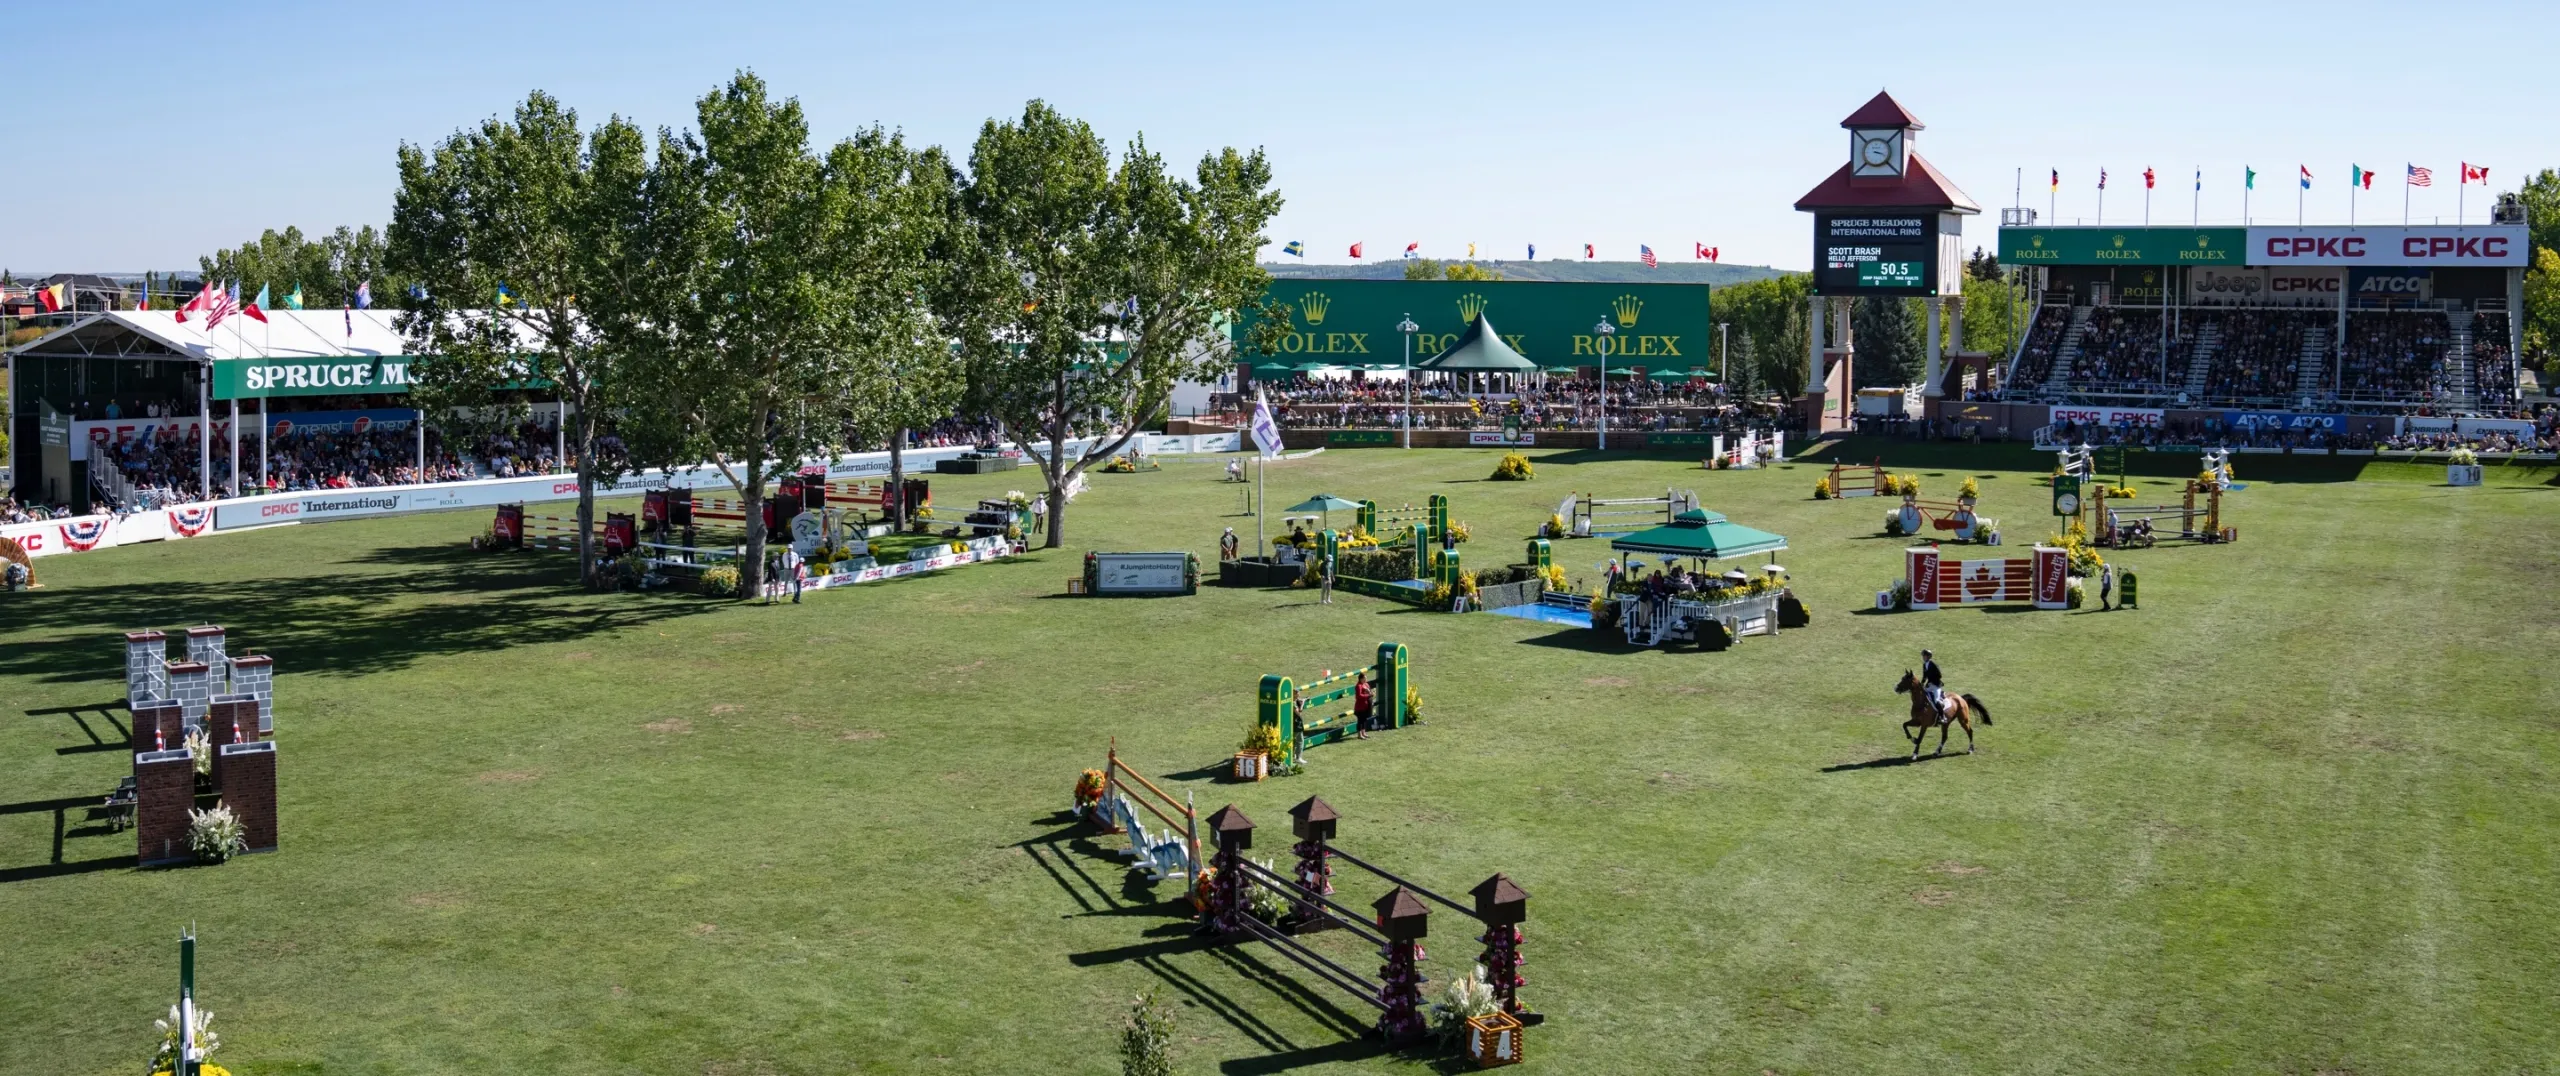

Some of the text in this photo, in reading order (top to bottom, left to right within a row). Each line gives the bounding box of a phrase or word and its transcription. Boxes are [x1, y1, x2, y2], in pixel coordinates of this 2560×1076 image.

[1831, 219, 1922, 227] SPRUCE MEADOWS
[1831, 228, 1922, 236] INTERNATIONAL RING
[1828, 247, 1881, 255] SCOTT BRASH
[2267, 237, 2366, 257] CPKC
[2403, 237, 2508, 257] CPKC
[2015, 250, 2059, 259] ROLEX
[2096, 250, 2141, 259] ROLEX
[2180, 250, 2226, 260] ROLEX
[1880, 262, 1909, 275] 50.5
[2196, 271, 2261, 296] Jeep
[2272, 277, 2339, 292] CPKC
[2359, 276, 2421, 292] ATCO
[2124, 287, 2172, 297] ROLEX
[1416, 333, 1527, 355] ROX
[1572, 335, 1682, 356] ROLEX
[246, 363, 373, 389] SPRUCE
[2055, 410, 2101, 421] CPKC
[2111, 412, 2158, 424] CPKC
[2465, 466, 2481, 482] 10
[553, 483, 581, 494] CPK
[261, 502, 300, 518] CPKC
[896, 564, 913, 573] CPKC
[926, 559, 943, 568] CPKC
[1120, 563, 1181, 571] #JumpIntoHistory
[833, 574, 852, 584] CPKC
[865, 569, 883, 578] CPKC
[1914, 555, 1937, 603] Canada
[2041, 554, 2066, 602] Canada
[1881, 594, 1889, 607] 8
[1238, 758, 1255, 777] 16
[1496, 1029, 1514, 1060] 4
